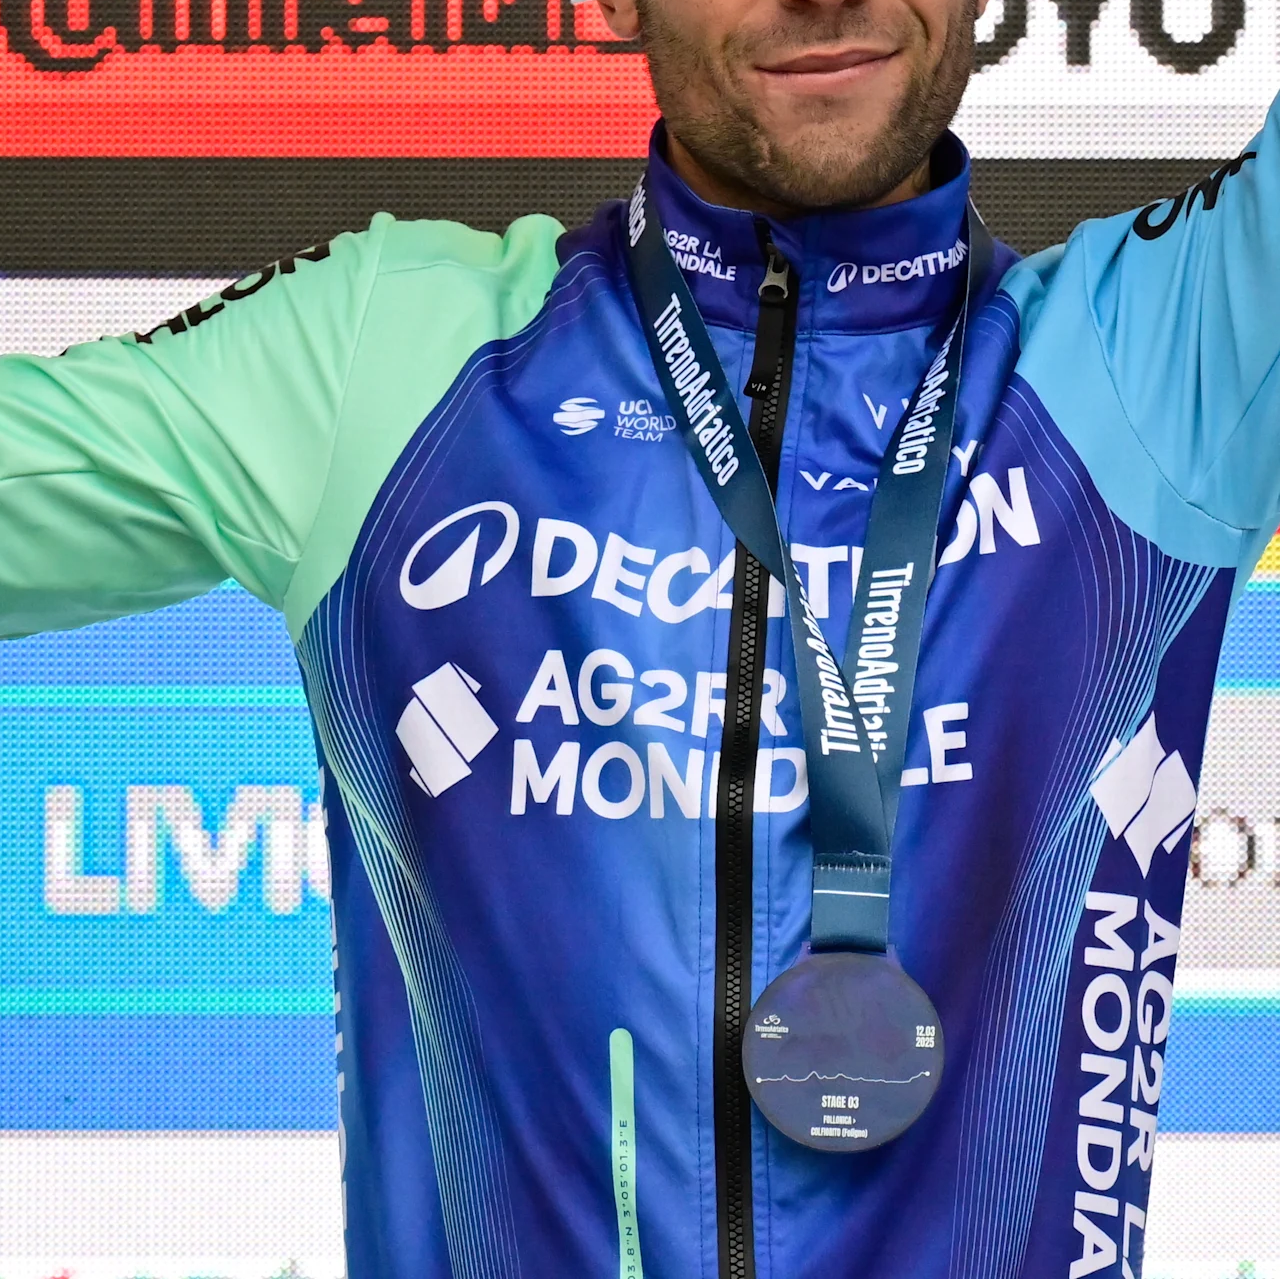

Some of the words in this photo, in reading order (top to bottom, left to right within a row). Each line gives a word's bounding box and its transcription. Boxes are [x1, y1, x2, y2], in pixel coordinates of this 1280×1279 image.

[670, 249, 737, 282] NDIALE
[654, 292, 739, 487] TirrenoAdriatico
[619, 399, 653, 415] UCI
[616, 415, 677, 432] WORLD
[613, 426, 664, 442] TEAM
[915, 1025, 936, 1037] 12.03
[1125, 899, 1181, 1174] AG2R
[915, 1037, 935, 1049] 2025
[821, 1095, 847, 1109] STAGE
[847, 1096, 860, 1109] 03
